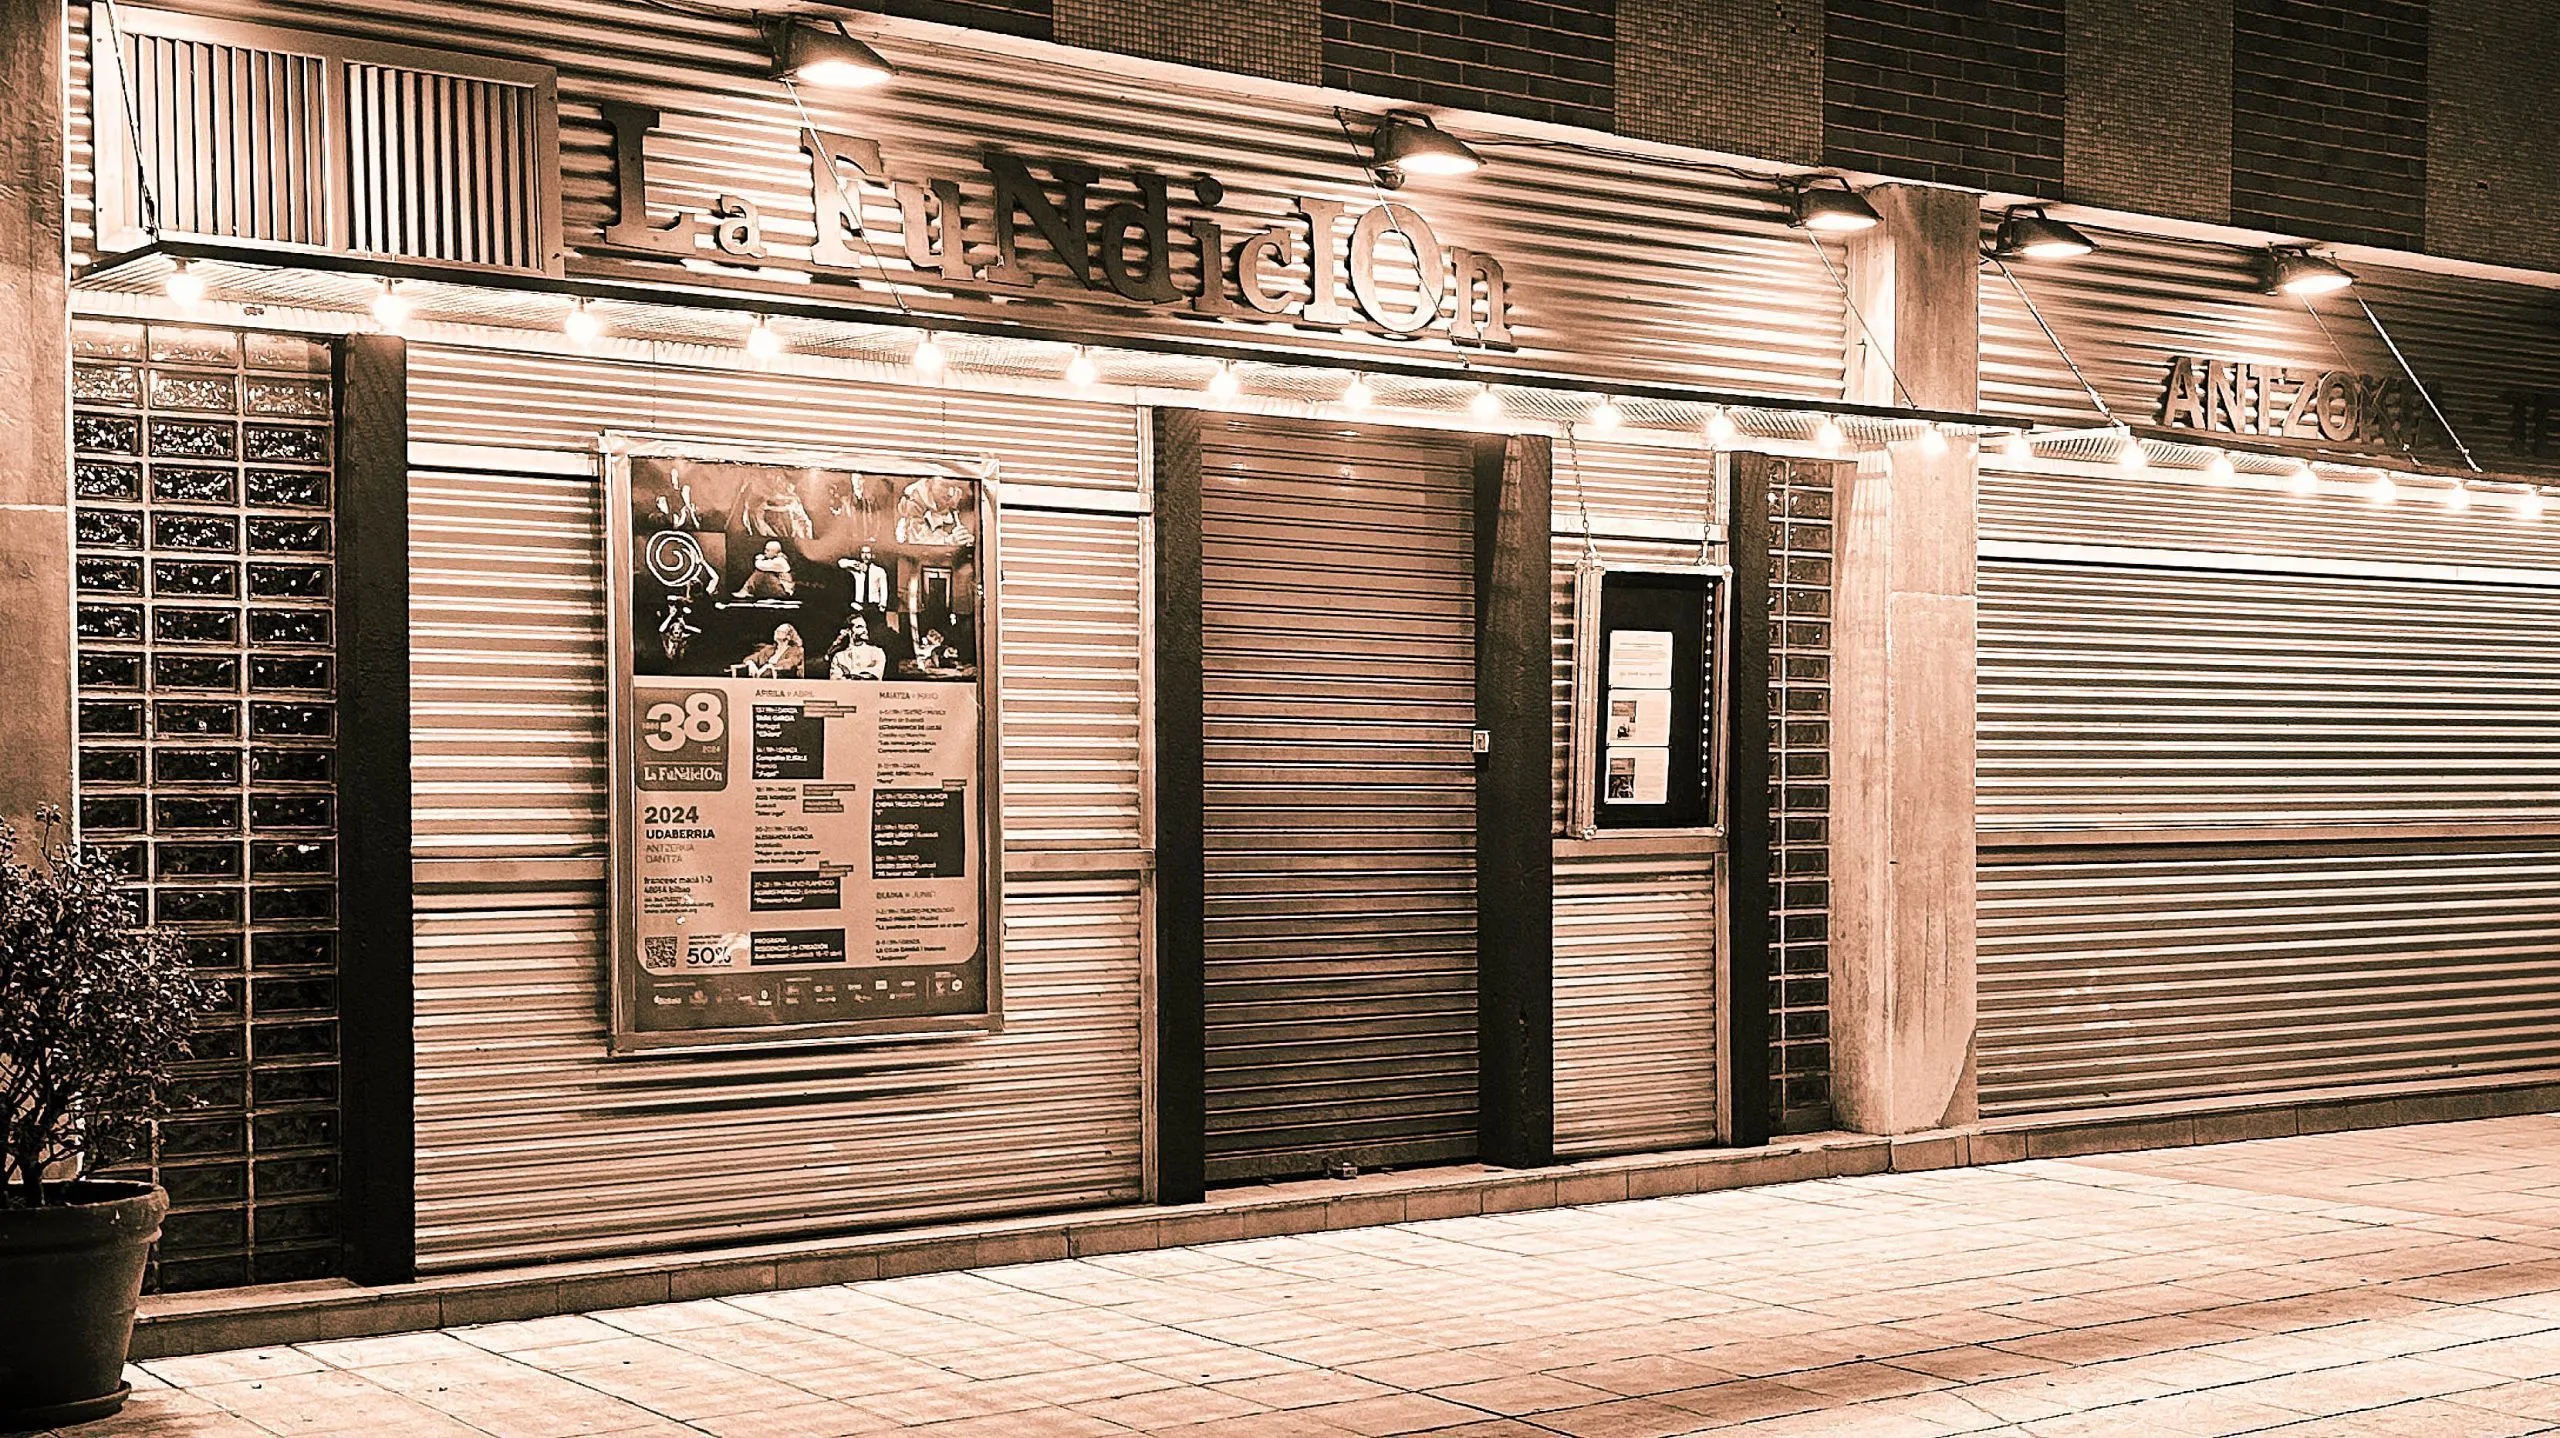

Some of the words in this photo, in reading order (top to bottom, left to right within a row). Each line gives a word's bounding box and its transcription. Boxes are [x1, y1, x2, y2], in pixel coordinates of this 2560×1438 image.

[601, 109, 766, 258] La
[801, 127, 1518, 352] FuNdicIOn
[644, 692, 724, 752] 38
[644, 766, 657, 781] La
[644, 806, 699, 824] 2024
[645, 828, 716, 840] UDABERRIA
[686, 946, 732, 965] 50%
